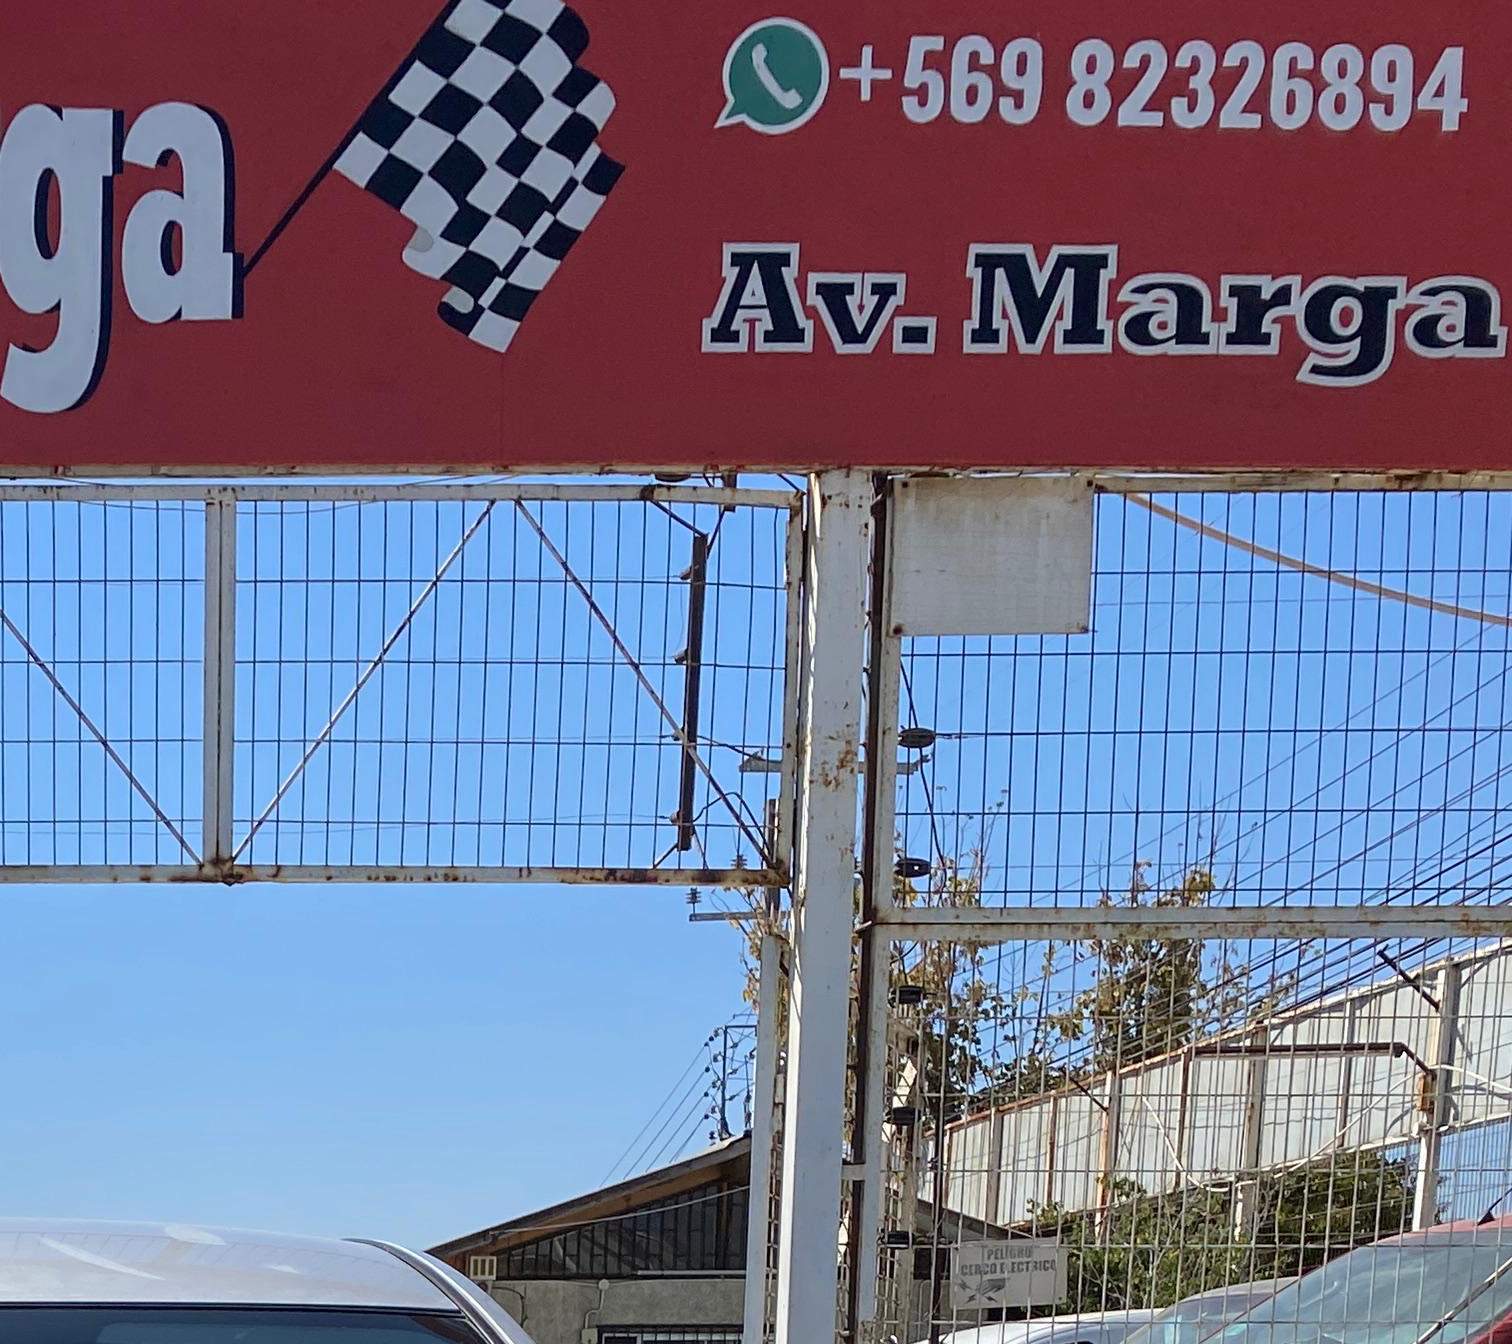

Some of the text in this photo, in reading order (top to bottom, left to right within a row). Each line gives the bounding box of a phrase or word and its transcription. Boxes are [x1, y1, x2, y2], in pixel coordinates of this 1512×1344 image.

[839, 34, 1469, 133] +569 82326894
[701, 242, 1508, 388] Av. Marga
[961, 1261, 997, 1276] CERCO
[986, 1246, 1032, 1261] PELIGRO
